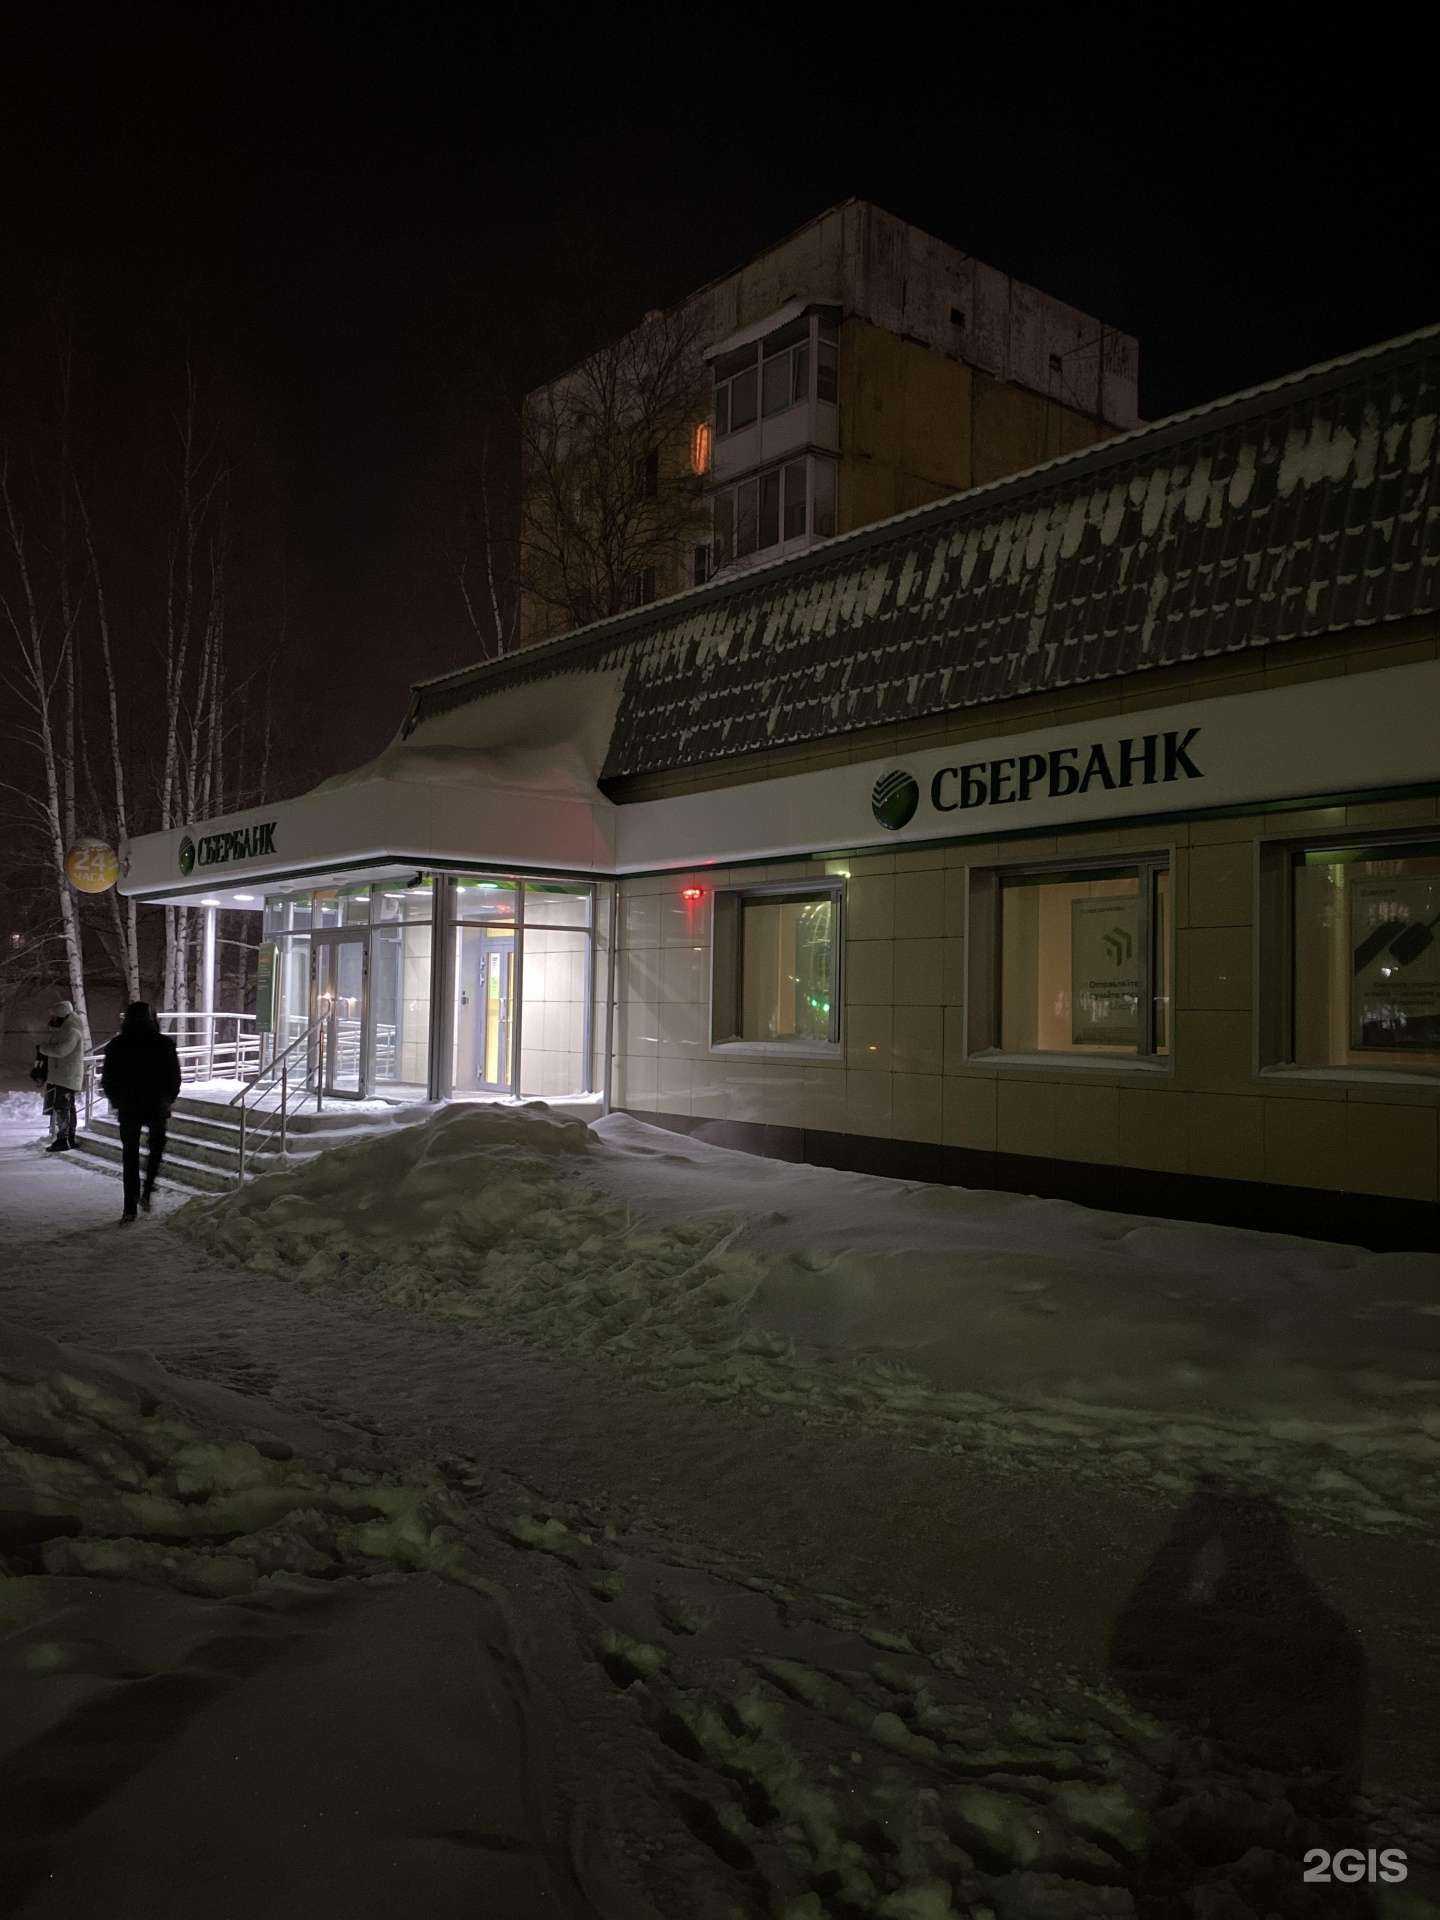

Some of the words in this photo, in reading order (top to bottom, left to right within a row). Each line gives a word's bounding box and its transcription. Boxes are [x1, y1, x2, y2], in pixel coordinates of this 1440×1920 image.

[931, 728, 1205, 811] СБЕРБАНК
[73, 849, 105, 871] 24
[197, 822, 278, 866] СБЕРБАНК
